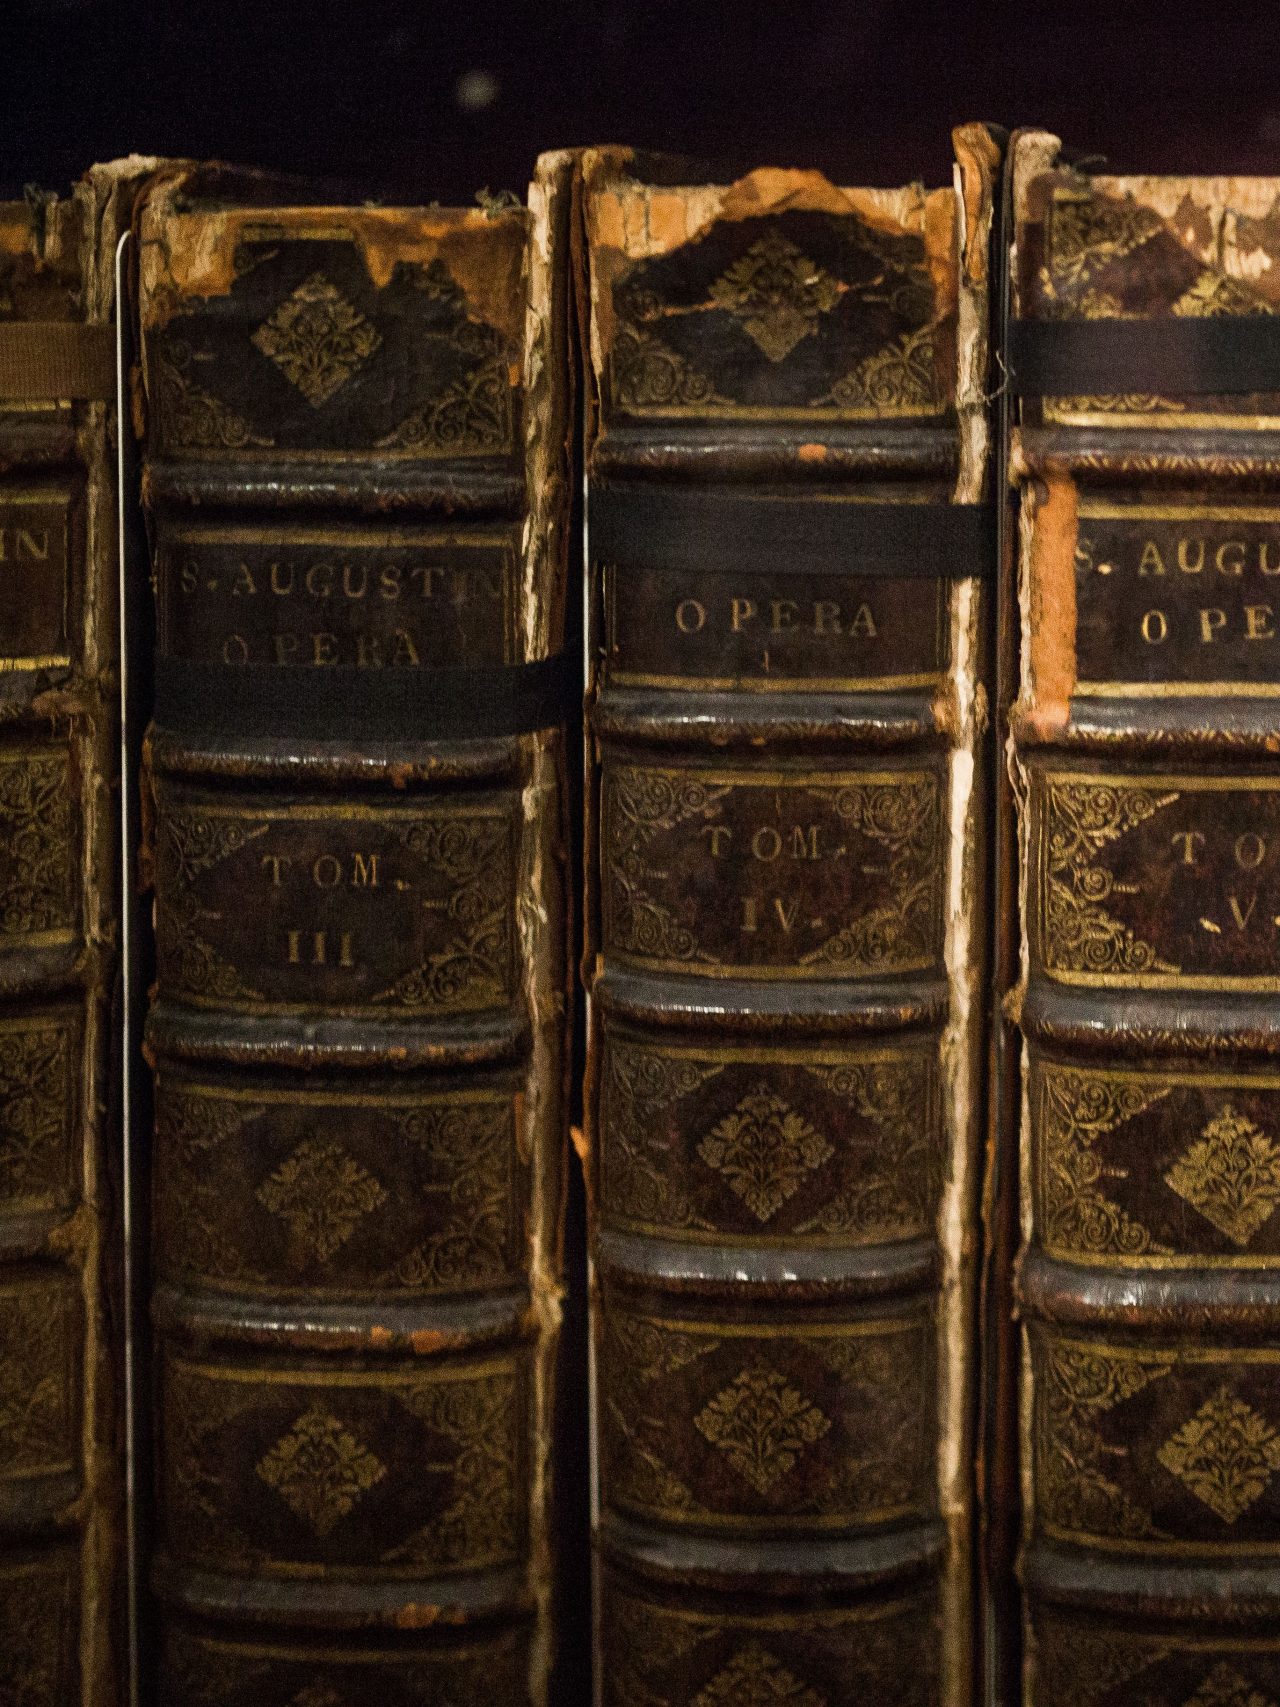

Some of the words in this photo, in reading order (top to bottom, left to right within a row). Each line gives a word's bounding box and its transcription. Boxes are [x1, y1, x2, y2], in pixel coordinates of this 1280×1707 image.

[674, 598, 878, 637] OPERA
[222, 628, 421, 667] OPERA
[286, 930, 354, 968] III
